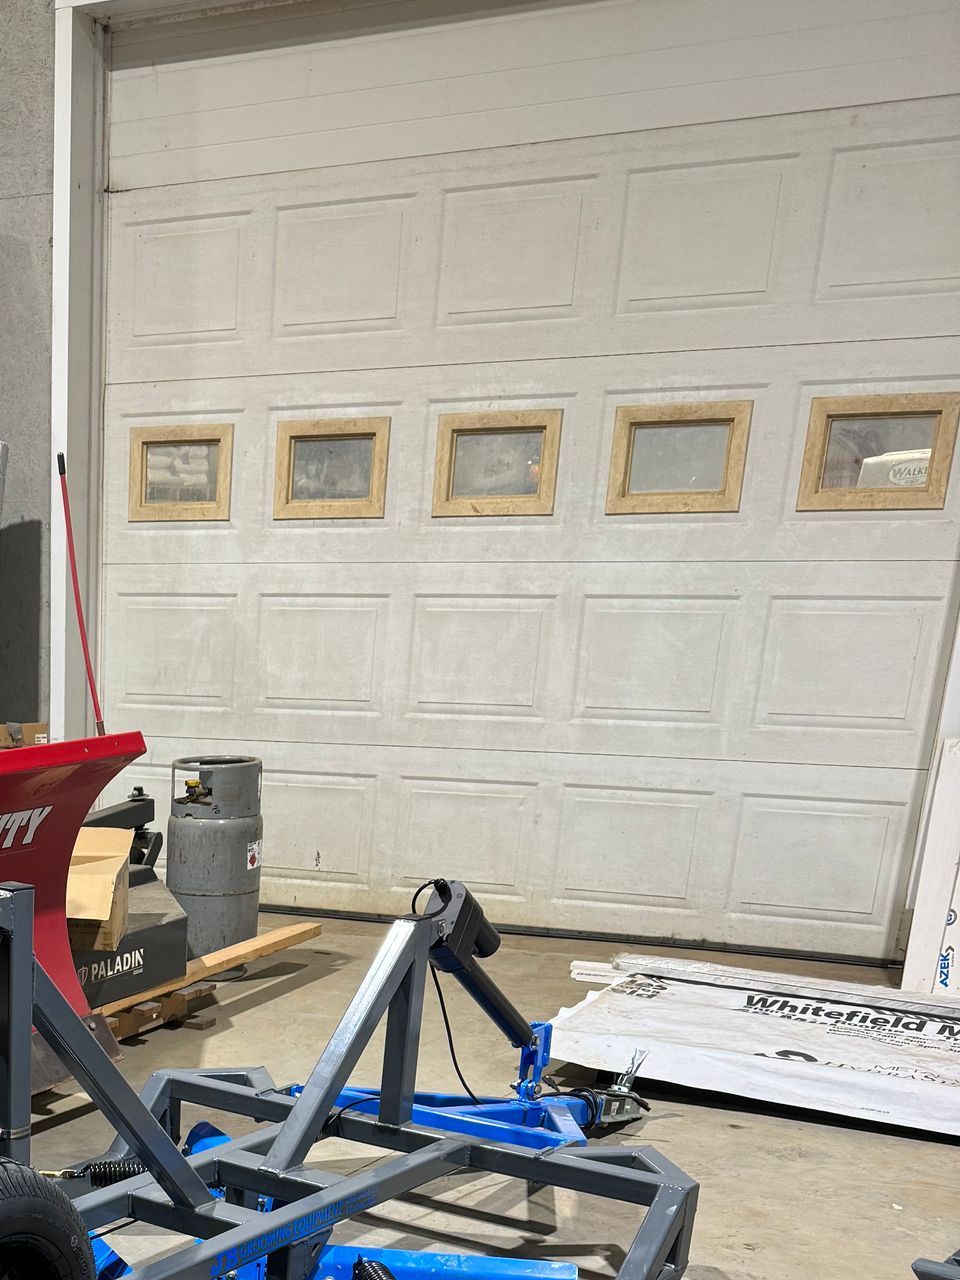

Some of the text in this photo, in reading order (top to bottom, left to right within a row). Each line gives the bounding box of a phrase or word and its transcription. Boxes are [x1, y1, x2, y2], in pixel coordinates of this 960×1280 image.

[91, 948, 144, 982] PALADIN
[939, 953, 950, 988] AZEK
[746, 994, 927, 1033] Whitefield
[210, 1200, 344, 1277] JB GROOMING EQUIPMENT
